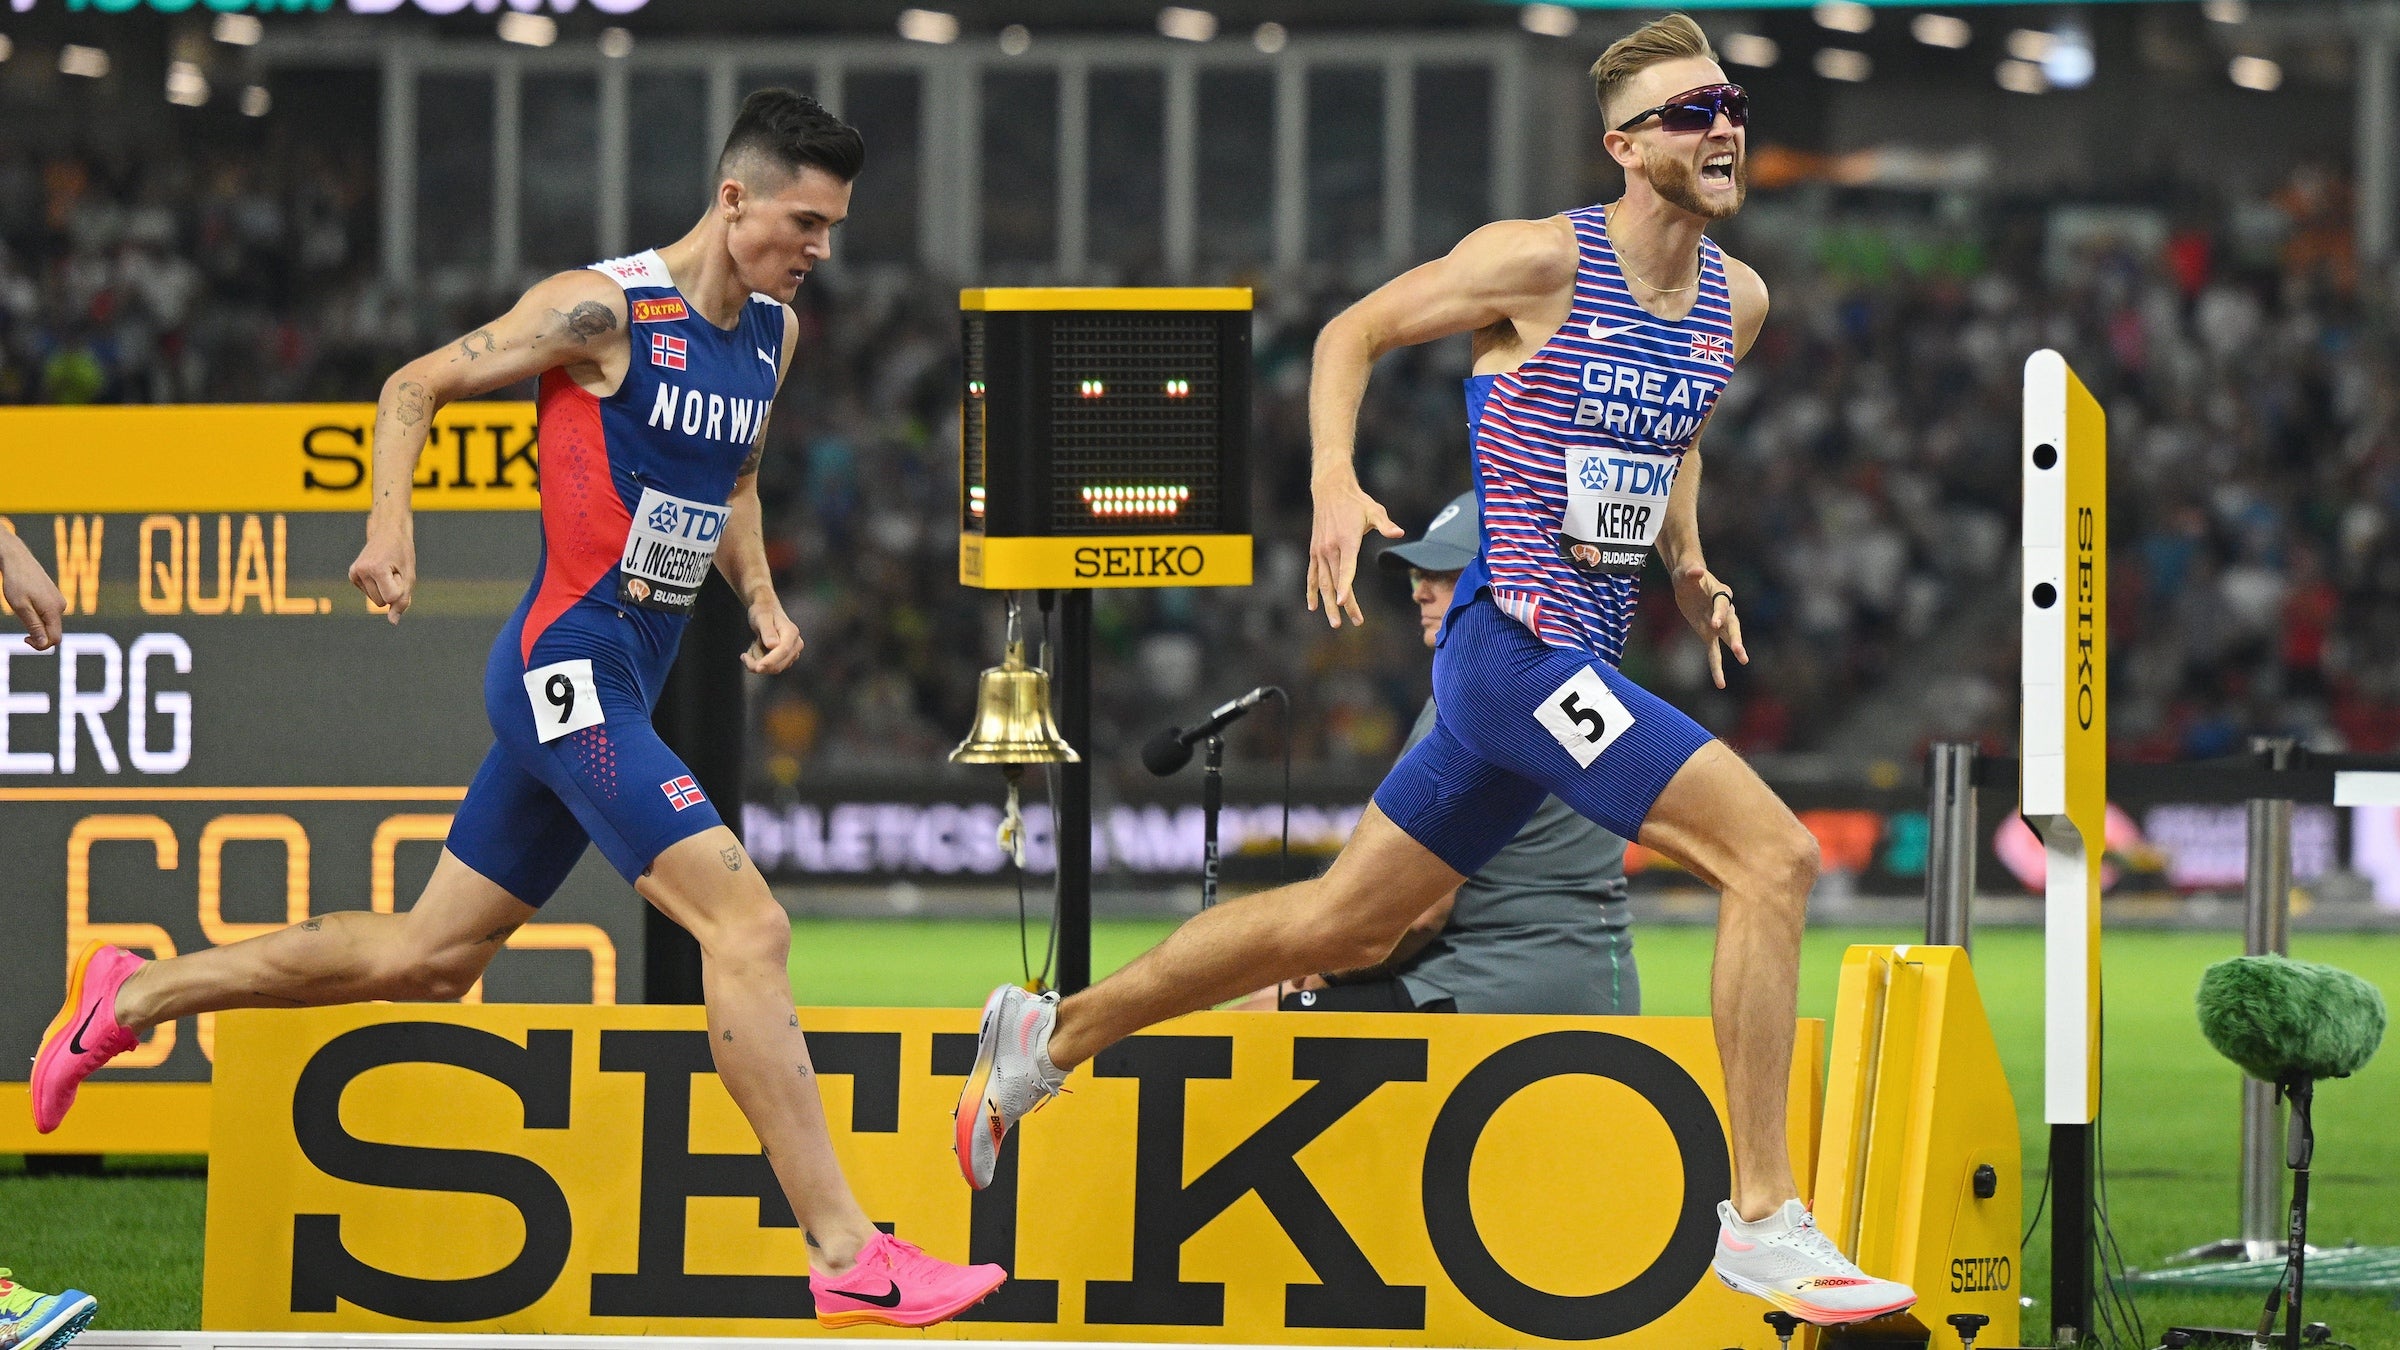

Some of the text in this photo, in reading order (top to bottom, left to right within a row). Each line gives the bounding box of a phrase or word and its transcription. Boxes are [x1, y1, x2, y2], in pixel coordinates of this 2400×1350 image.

[650, 303, 683, 316] EXTRA
[1582, 361, 1715, 412] GREAT
[1573, 397, 1703, 441] BRITAIN
[1608, 456, 1675, 497] TDK
[1596, 502, 1652, 541] KERR
[53, 513, 105, 615] W
[138, 513, 333, 616] QUAL.
[626, 536, 642, 571] J.
[1074, 545, 1205, 579] SEIKO
[2077, 506, 2093, 731] SEIKO
[0, 632, 193, 775] ERG
[545, 673, 575, 724] 9
[1559, 690, 1606, 744] 5
[290, 1020, 1732, 1341] SEIKO
[1951, 1255, 2011, 1294] SEIKO
